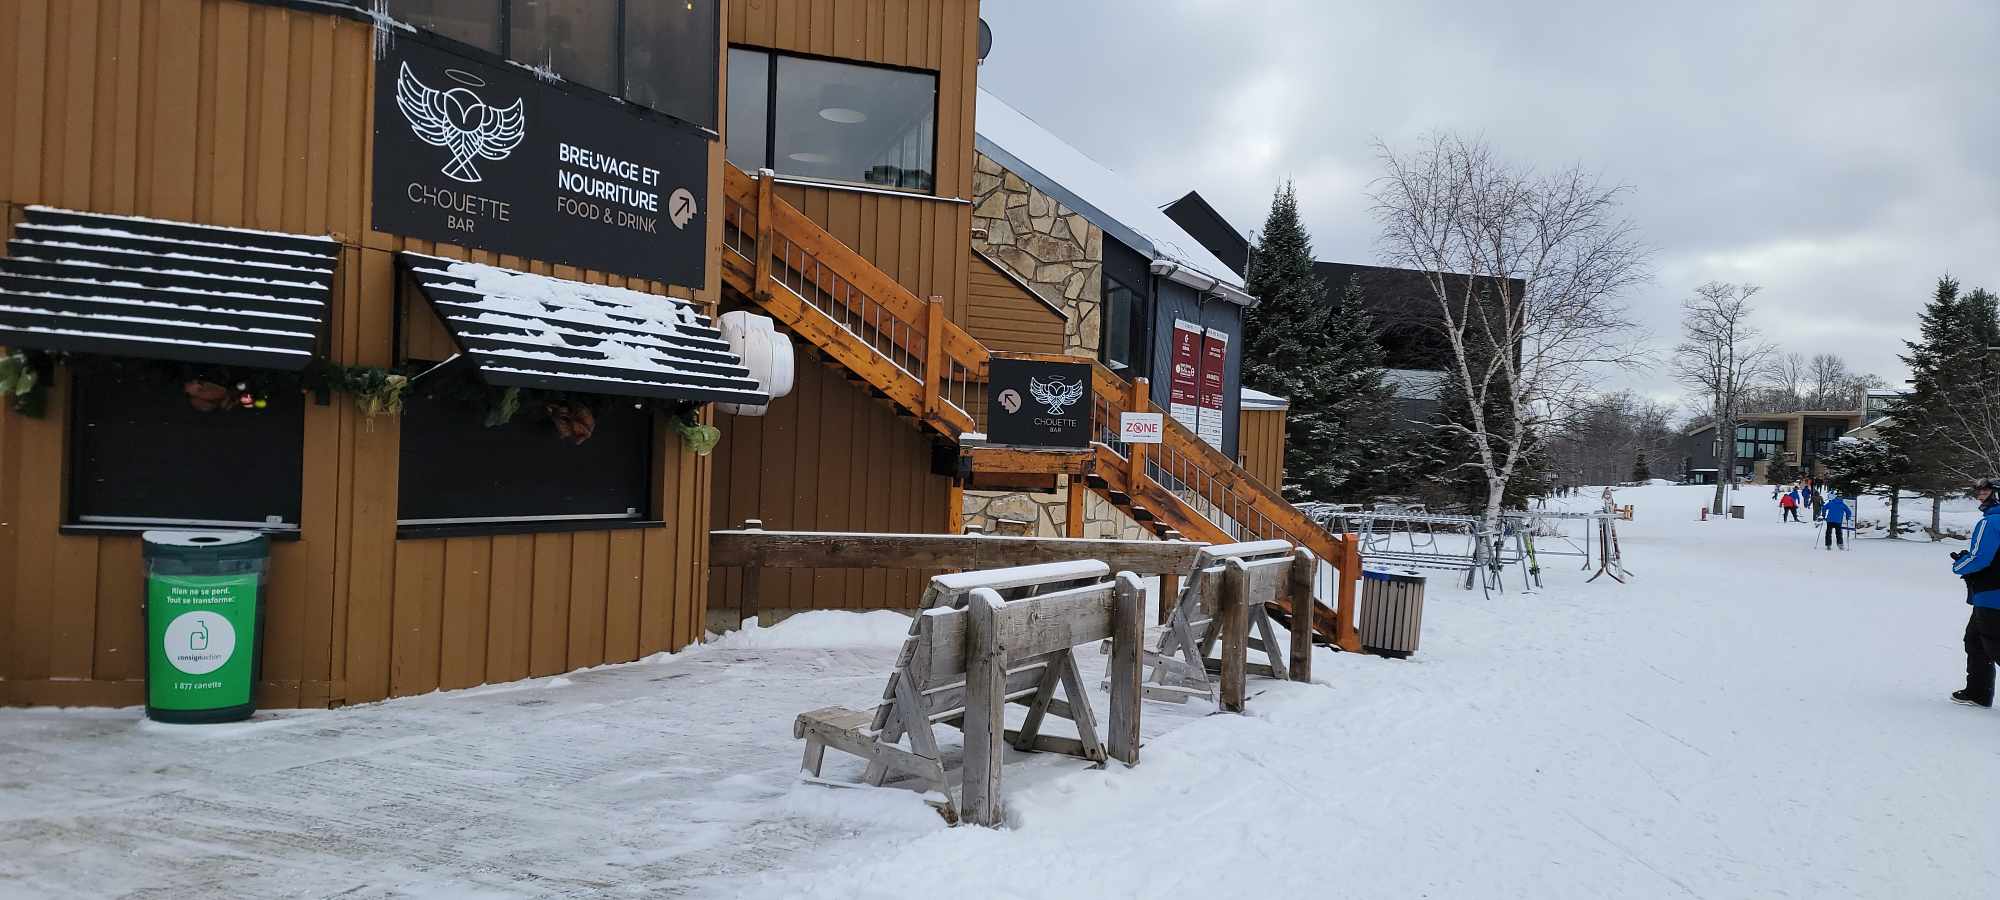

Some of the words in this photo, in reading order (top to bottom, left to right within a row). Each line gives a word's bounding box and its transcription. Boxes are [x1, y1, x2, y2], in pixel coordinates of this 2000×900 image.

[559, 142, 639, 182] BREUVAGE
[642, 166, 660, 187] ET
[558, 169, 659, 212] NOURRITURE
[407, 182, 512, 223] CHOUETTE
[447, 215, 475, 233] BAR
[557, 196, 600, 221] FOOD
[602, 208, 614, 225] &
[617, 209, 657, 234] DRINK
[1033, 417, 1077, 428] CHOUETTE
[1126, 422, 1158, 434] ZONE
[167, 596, 181, 604] Tout
[179, 682, 192, 690] 877
